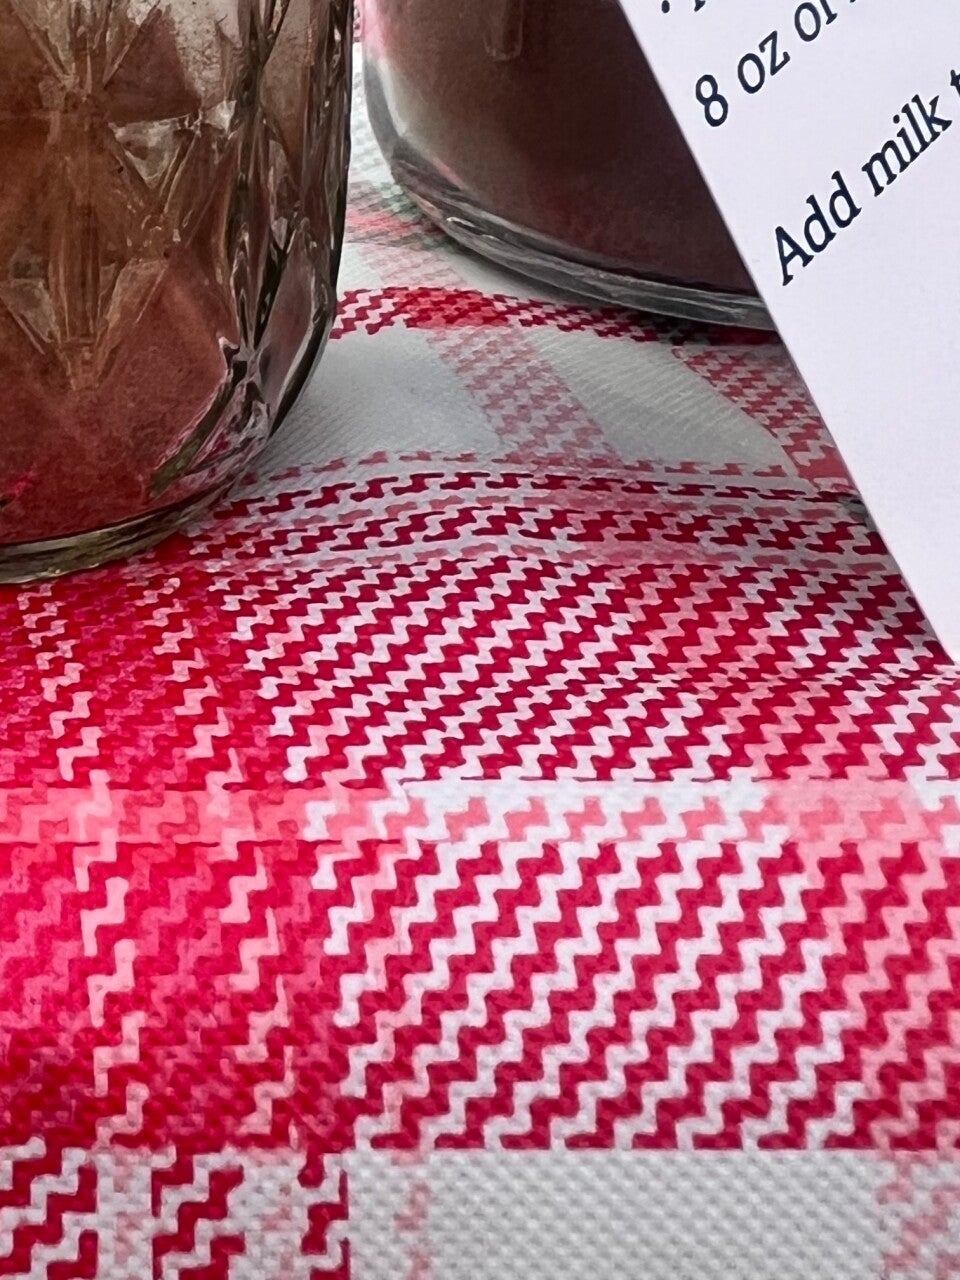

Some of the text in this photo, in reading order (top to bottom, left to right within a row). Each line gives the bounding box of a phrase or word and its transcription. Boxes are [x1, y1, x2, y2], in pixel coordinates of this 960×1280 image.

[695, 74, 729, 127] 8
[737, 30, 790, 94] oz
[775, 93, 952, 286] Add milk
